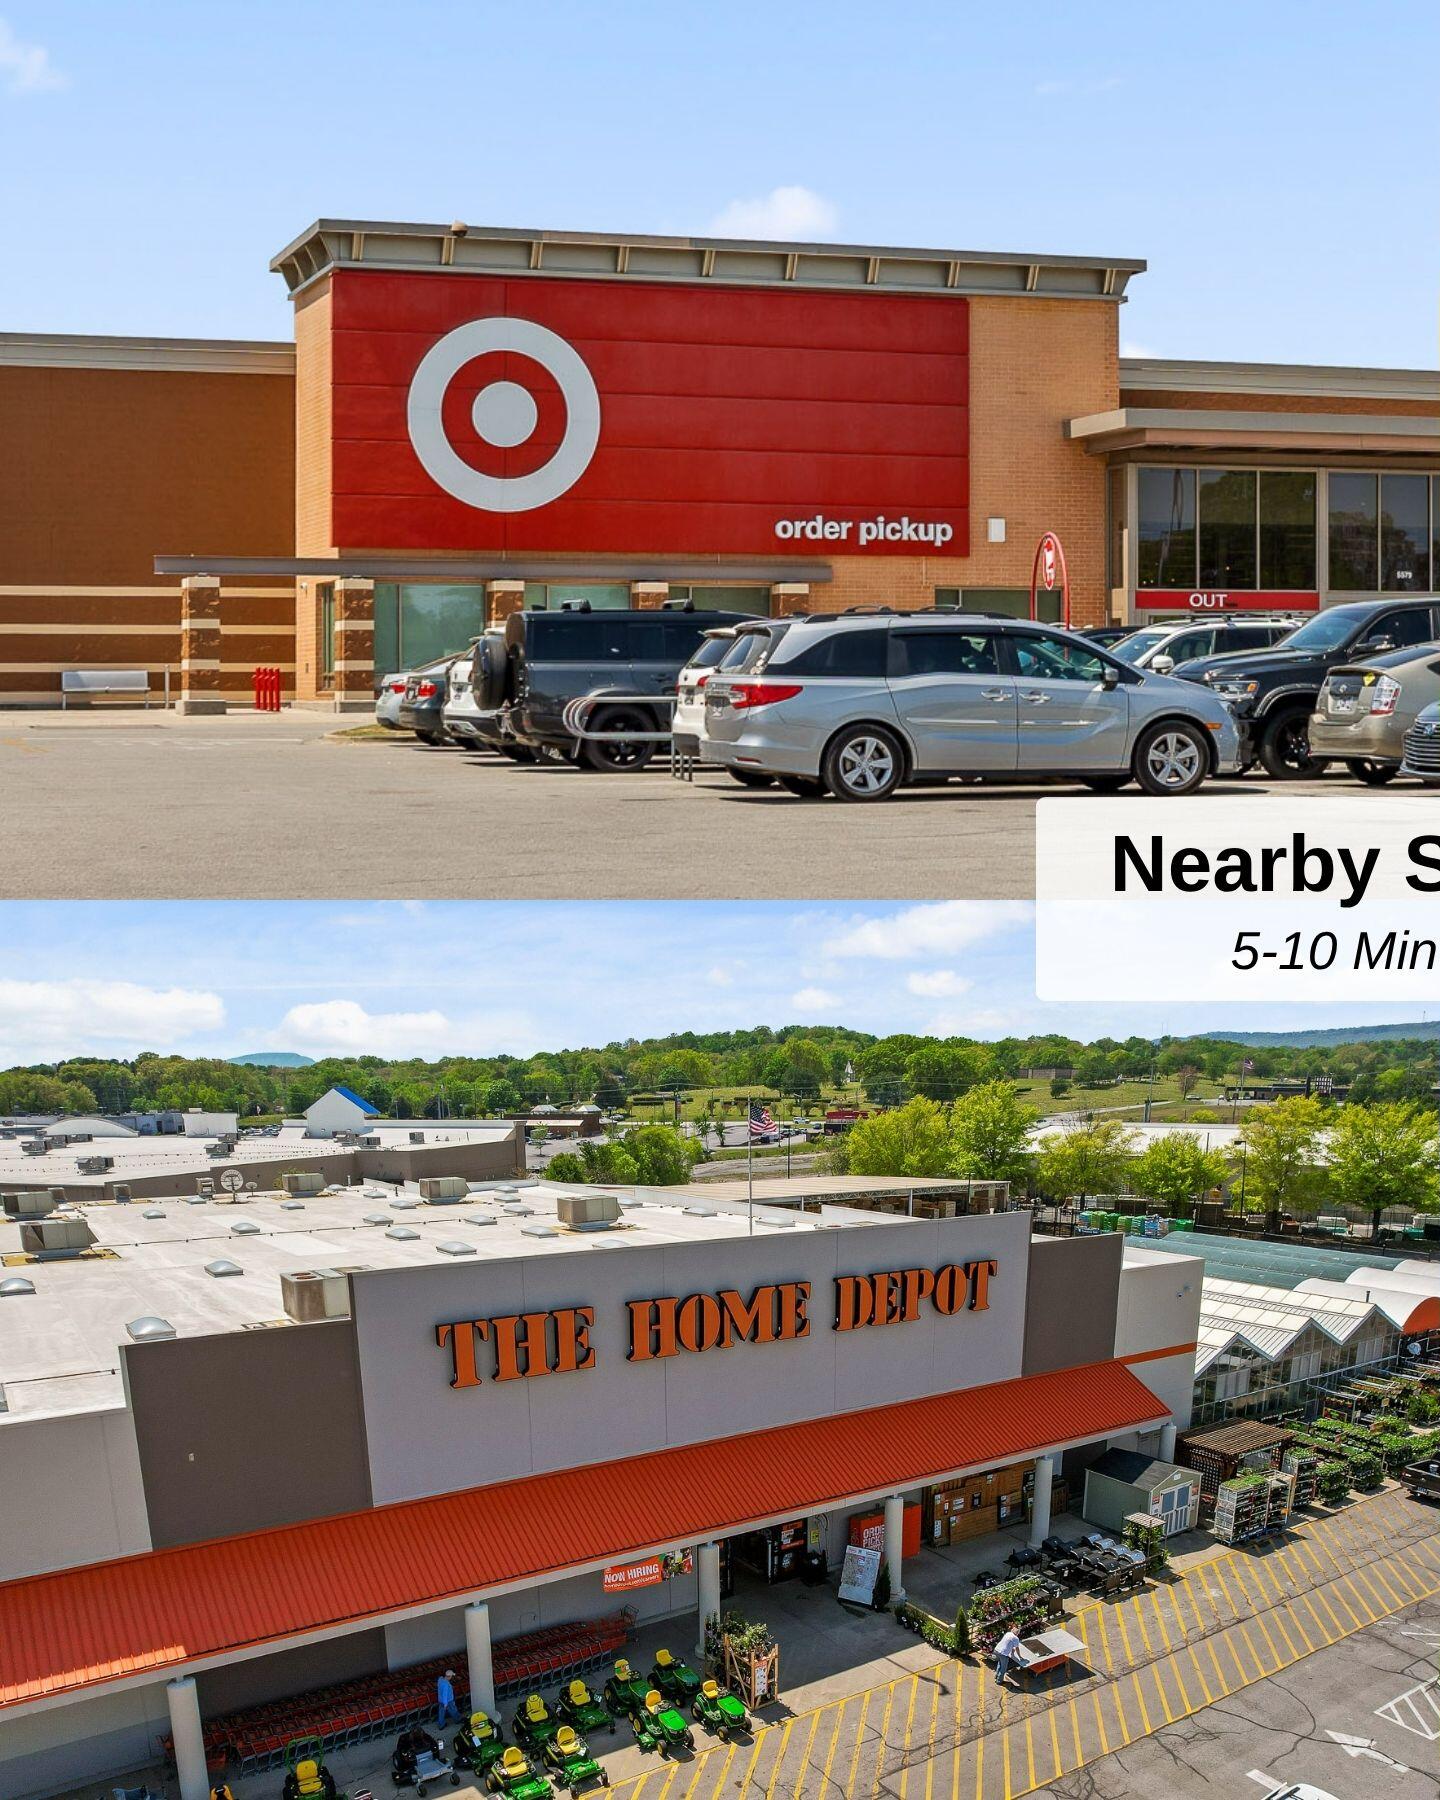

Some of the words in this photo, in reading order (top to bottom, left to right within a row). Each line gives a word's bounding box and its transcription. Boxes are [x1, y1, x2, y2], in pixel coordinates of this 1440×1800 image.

[774, 517, 857, 541] order
[859, 516, 953, 547] pickup
[1189, 593, 1227, 608] OUT
[436, 1306, 596, 1389] THE
[626, 1281, 811, 1362] HOME
[833, 1259, 998, 1332] DEPOT
[863, 1524, 885, 1539] ORDE
[604, 1571, 625, 1583] NOW
[627, 1564, 659, 1579] HIRING
